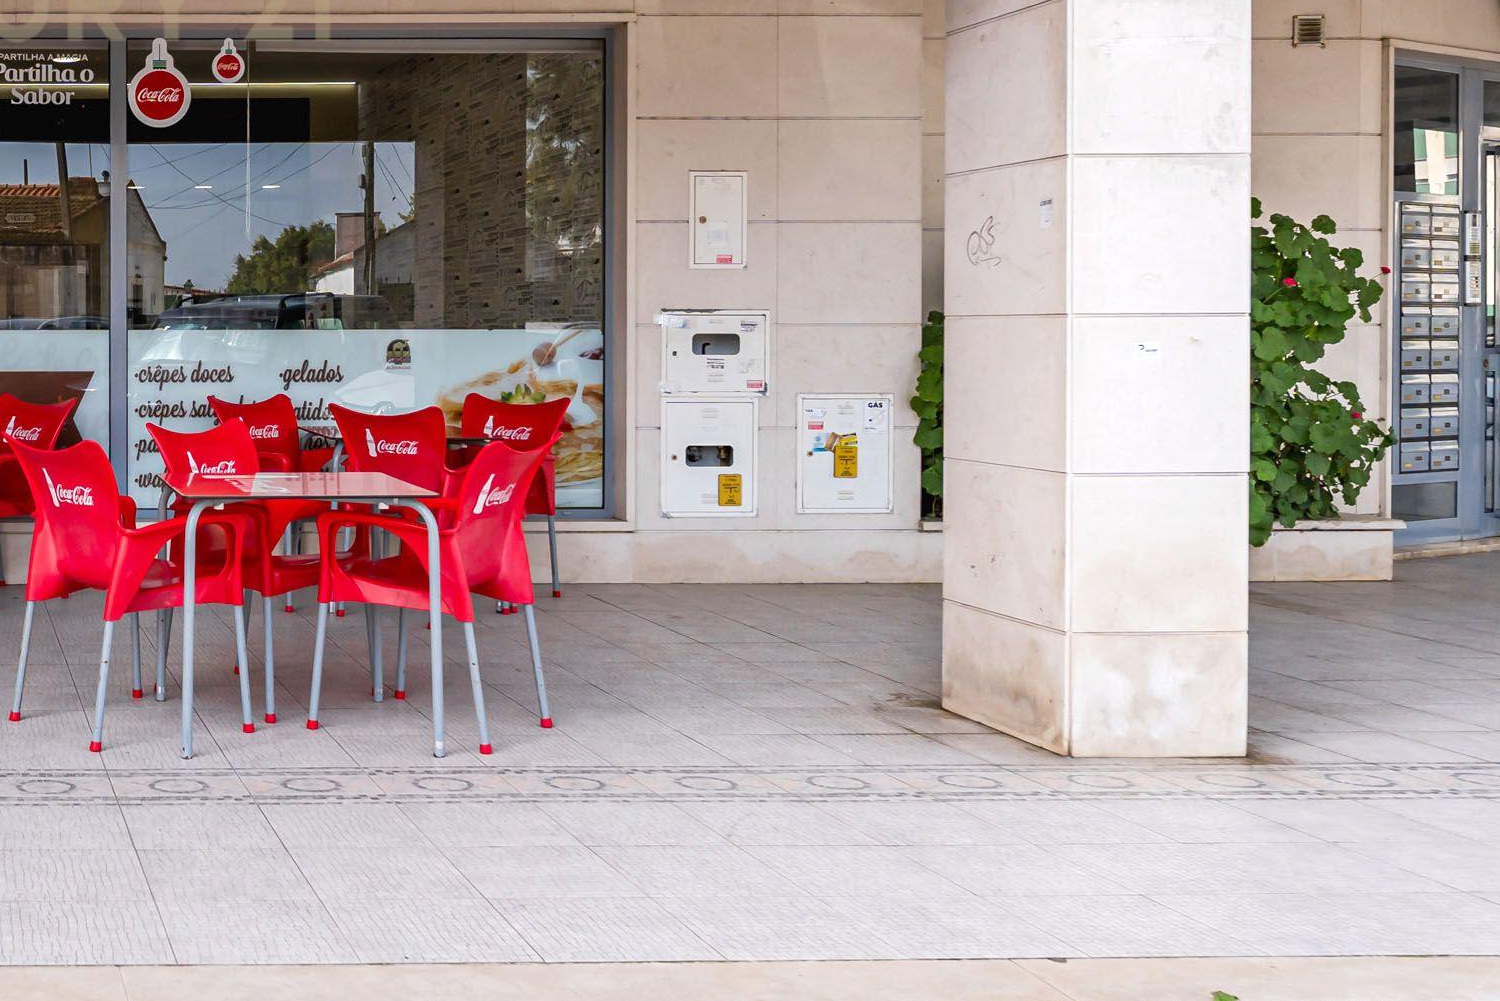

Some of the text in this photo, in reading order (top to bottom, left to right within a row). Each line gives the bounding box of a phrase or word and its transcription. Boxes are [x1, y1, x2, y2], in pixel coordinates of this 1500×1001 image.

[47, 53, 54, 61] A
[79, 68, 95, 83] o
[10, 86, 75, 105] Sabor
[137, 87, 181, 103] Coca-Cola
[139, 359, 235, 391] crêpes doces
[282, 359, 344, 391] gelados
[138, 400, 187, 426] crêpes
[294, 397, 334, 421] atido
[12, 426, 42, 441] Coca-Cola
[249, 424, 279, 439] Coca-Cola
[493, 426, 533, 441] Coca-Cola
[377, 439, 419, 455] Coca-Cola
[56, 483, 95, 507] Coca-Cola
